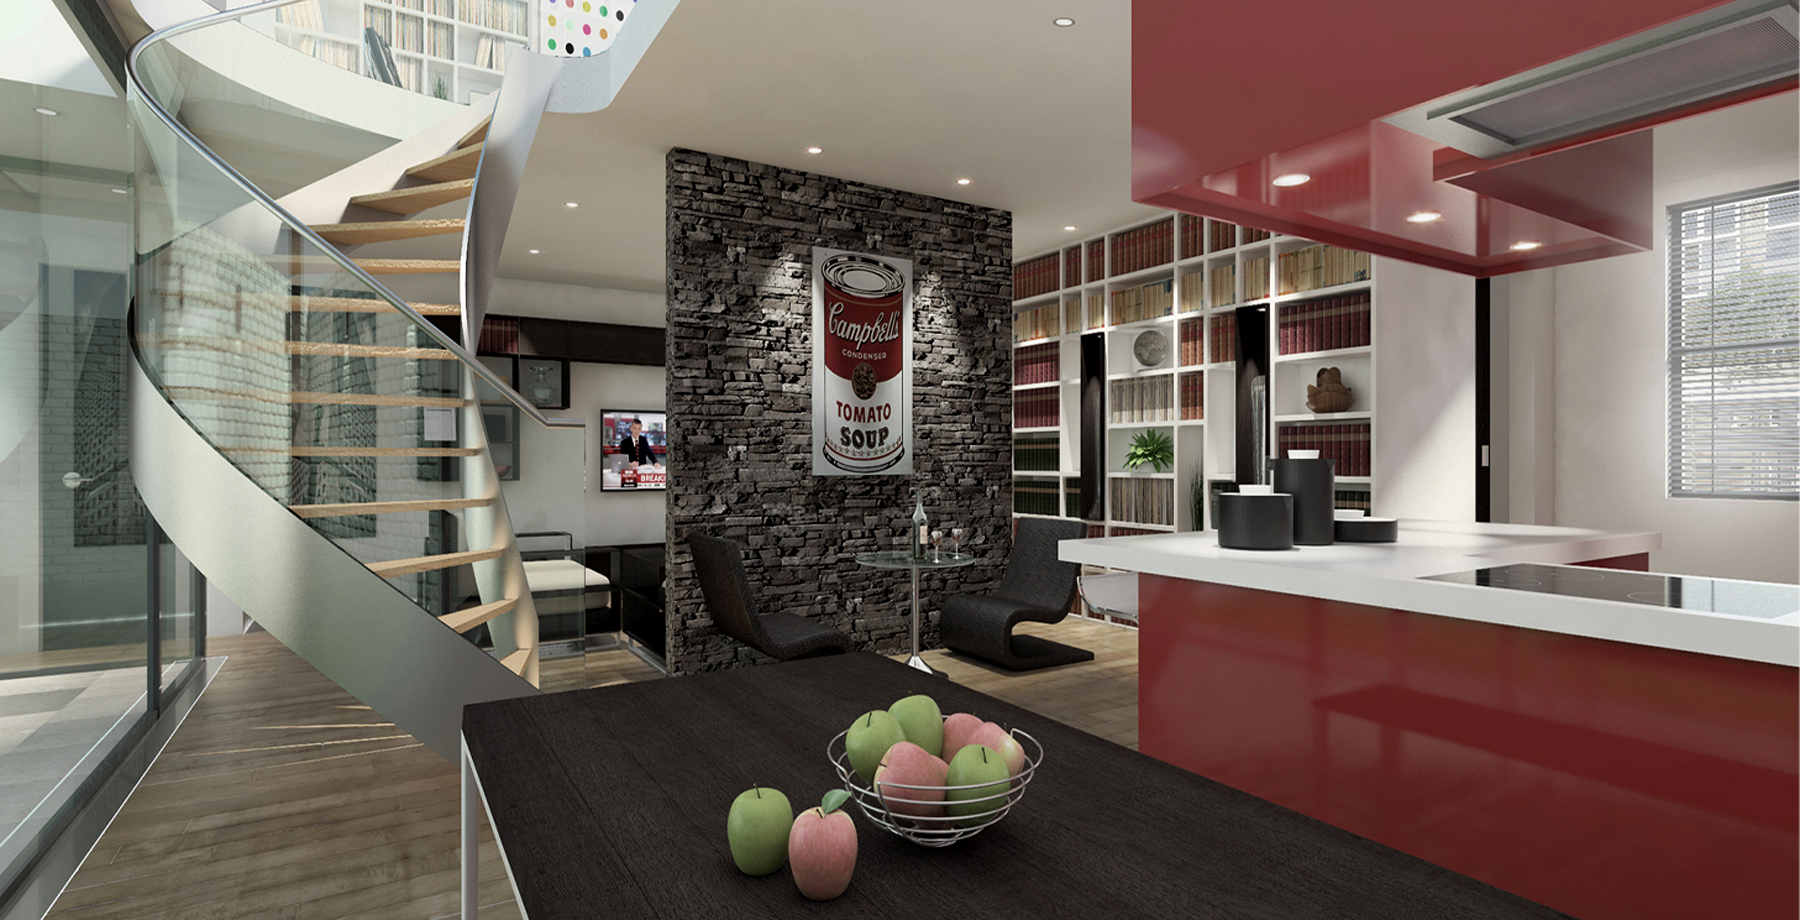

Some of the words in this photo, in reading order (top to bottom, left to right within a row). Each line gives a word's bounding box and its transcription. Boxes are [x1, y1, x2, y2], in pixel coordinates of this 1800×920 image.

[828, 301, 900, 350] Campbell's
[841, 348, 887, 361] CONDENSED
[836, 400, 892, 423] TOMATO
[840, 426, 889, 450] SOUP
